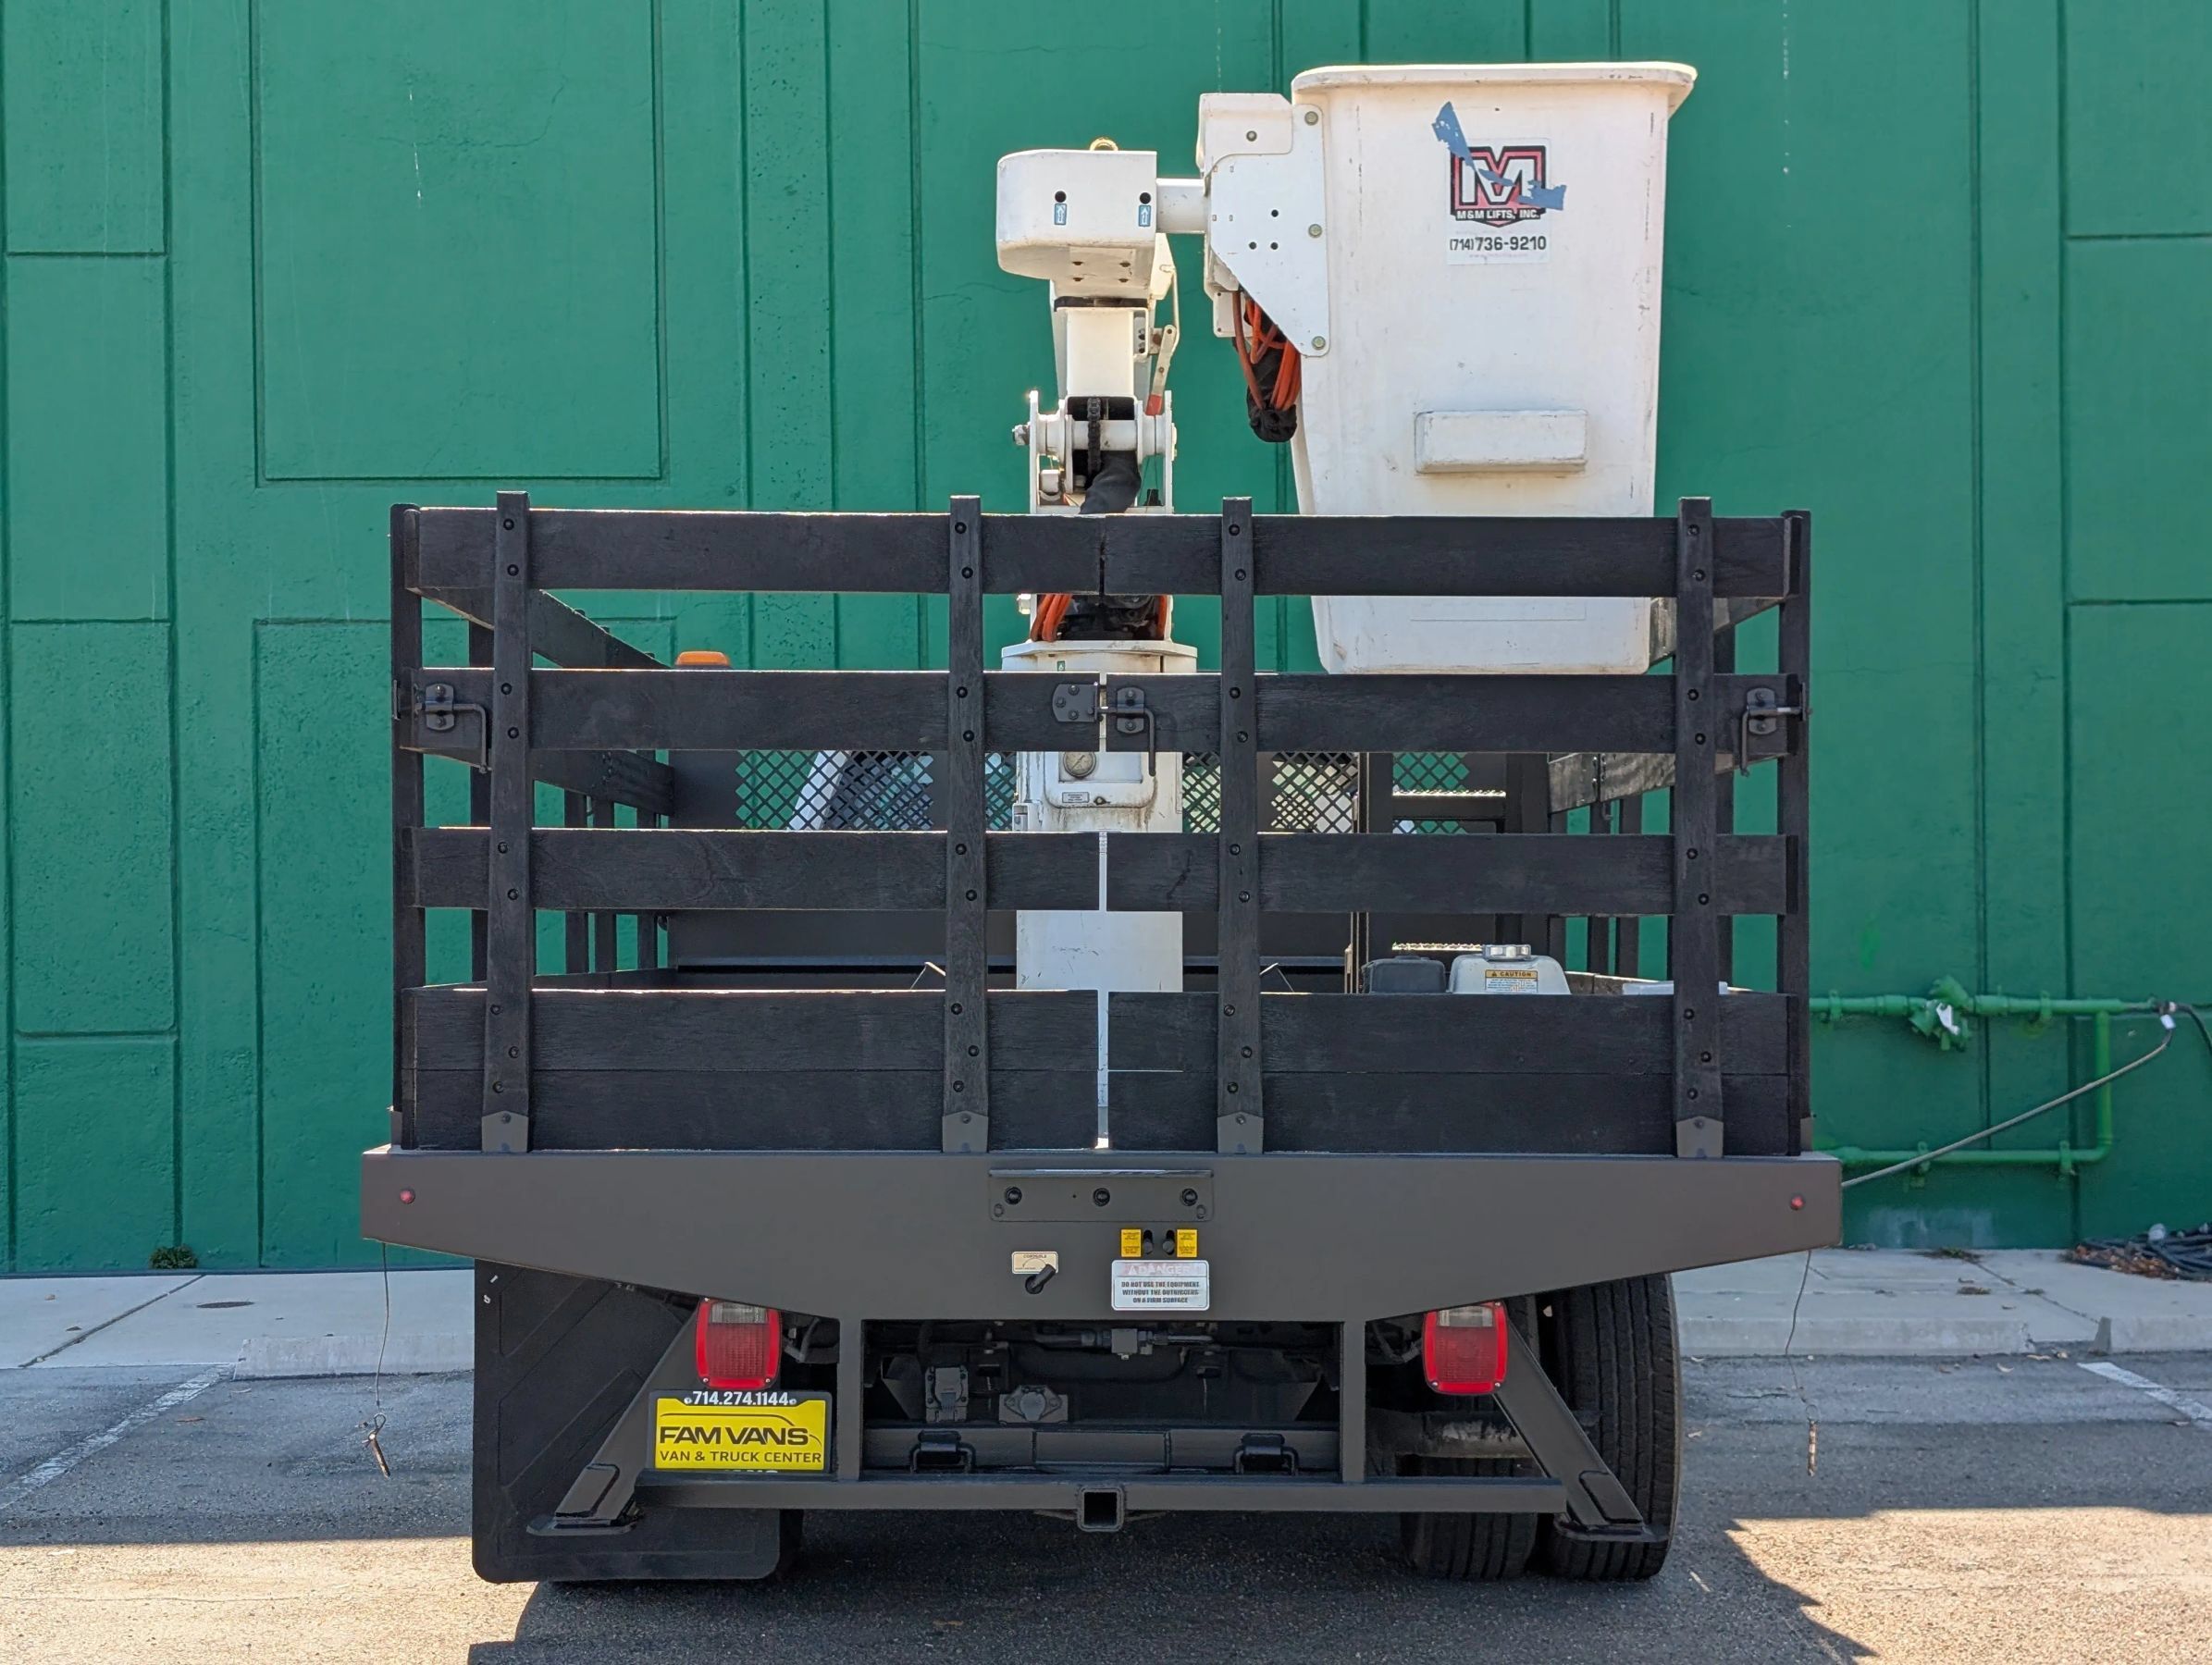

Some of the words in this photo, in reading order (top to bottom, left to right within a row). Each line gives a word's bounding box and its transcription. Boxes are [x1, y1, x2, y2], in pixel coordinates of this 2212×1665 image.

[1457, 210, 1484, 219] M&M
[1519, 209, 1539, 218] INC.
[693, 1390, 789, 1405] 714.274.1144
[660, 1426, 721, 1445] FAM
[725, 1426, 809, 1446] VANS
[660, 1450, 690, 1462] VAN
[694, 1450, 705, 1462] &
[710, 1450, 760, 1462] TRUCK
[764, 1451, 822, 1463] CENTER
